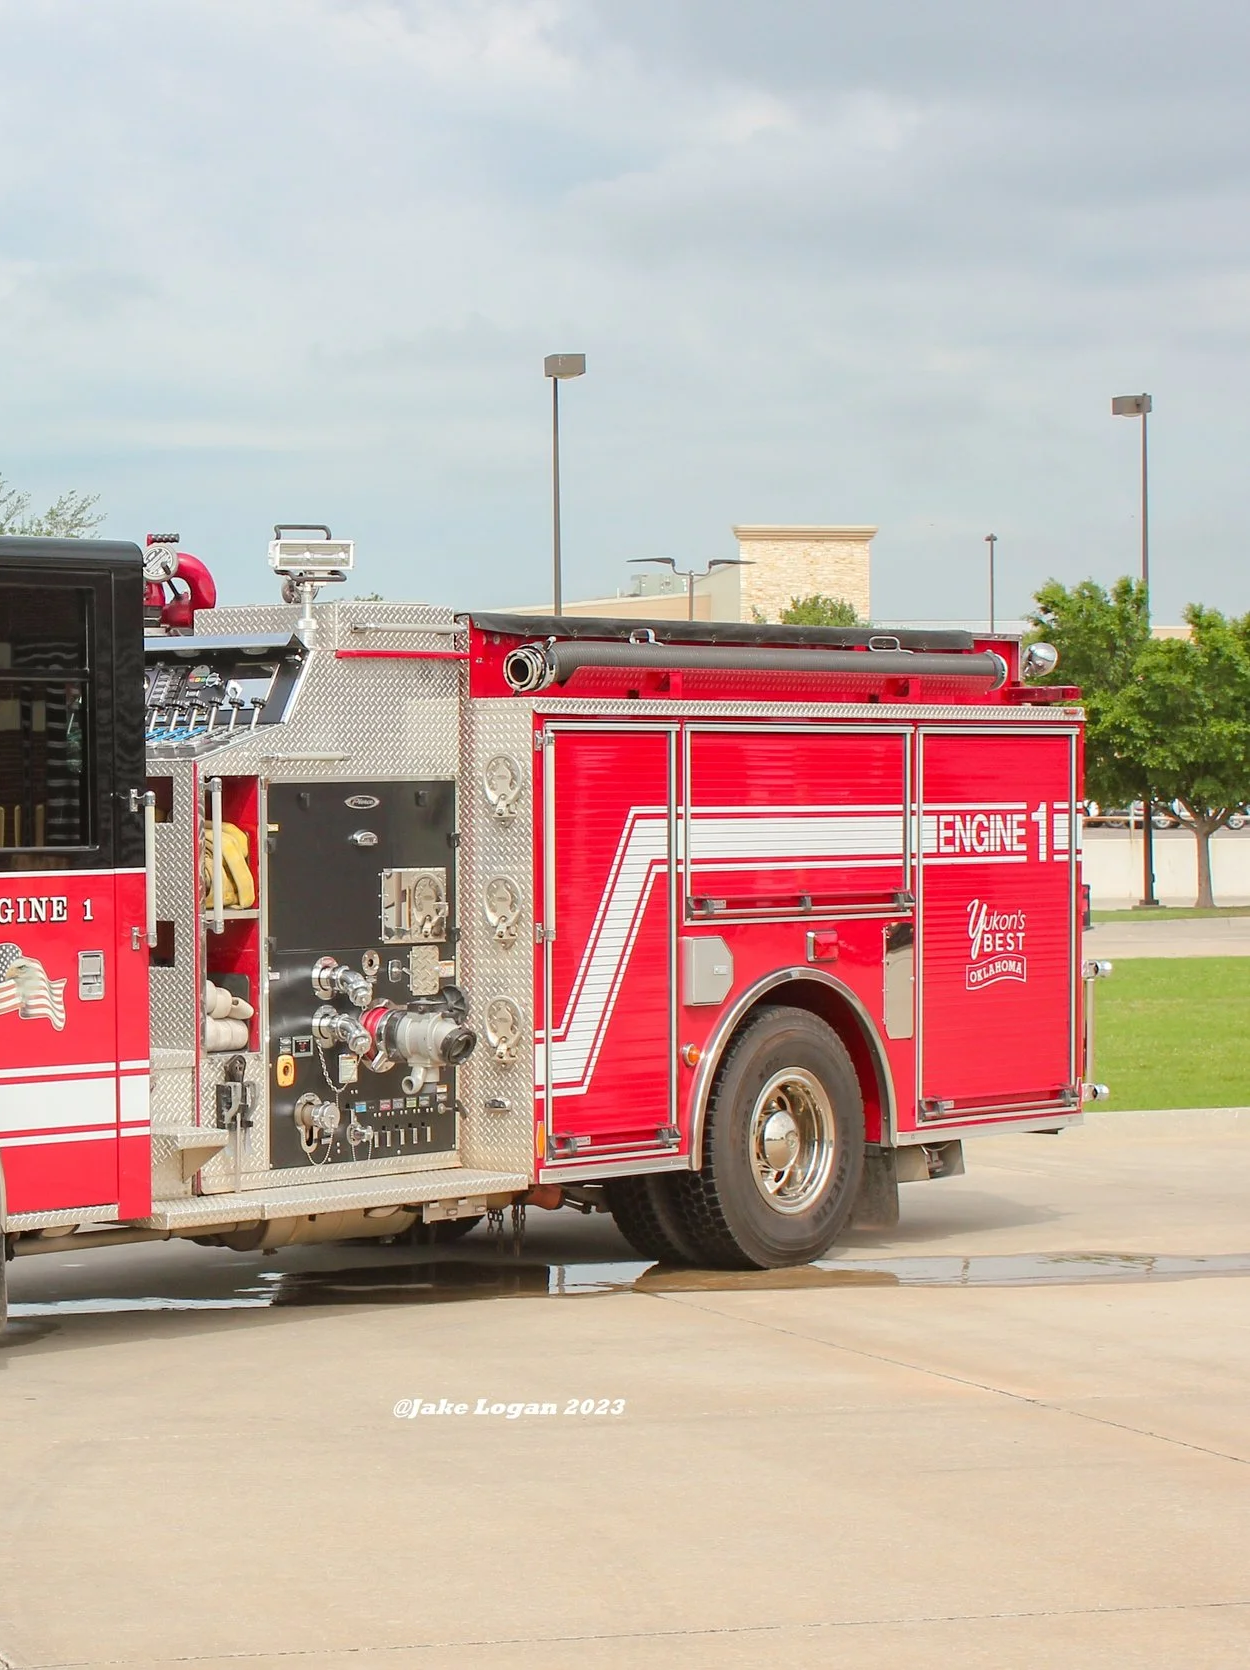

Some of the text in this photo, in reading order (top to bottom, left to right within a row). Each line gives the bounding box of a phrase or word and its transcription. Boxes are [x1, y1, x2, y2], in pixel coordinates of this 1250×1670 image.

[939, 801, 1047, 862] ENGINE 1
[82, 898, 95, 921] 1
[966, 899, 1026, 960] Yukon's
[983, 932, 1026, 952] BEST
[969, 961, 1023, 983] OKLAHOMA
